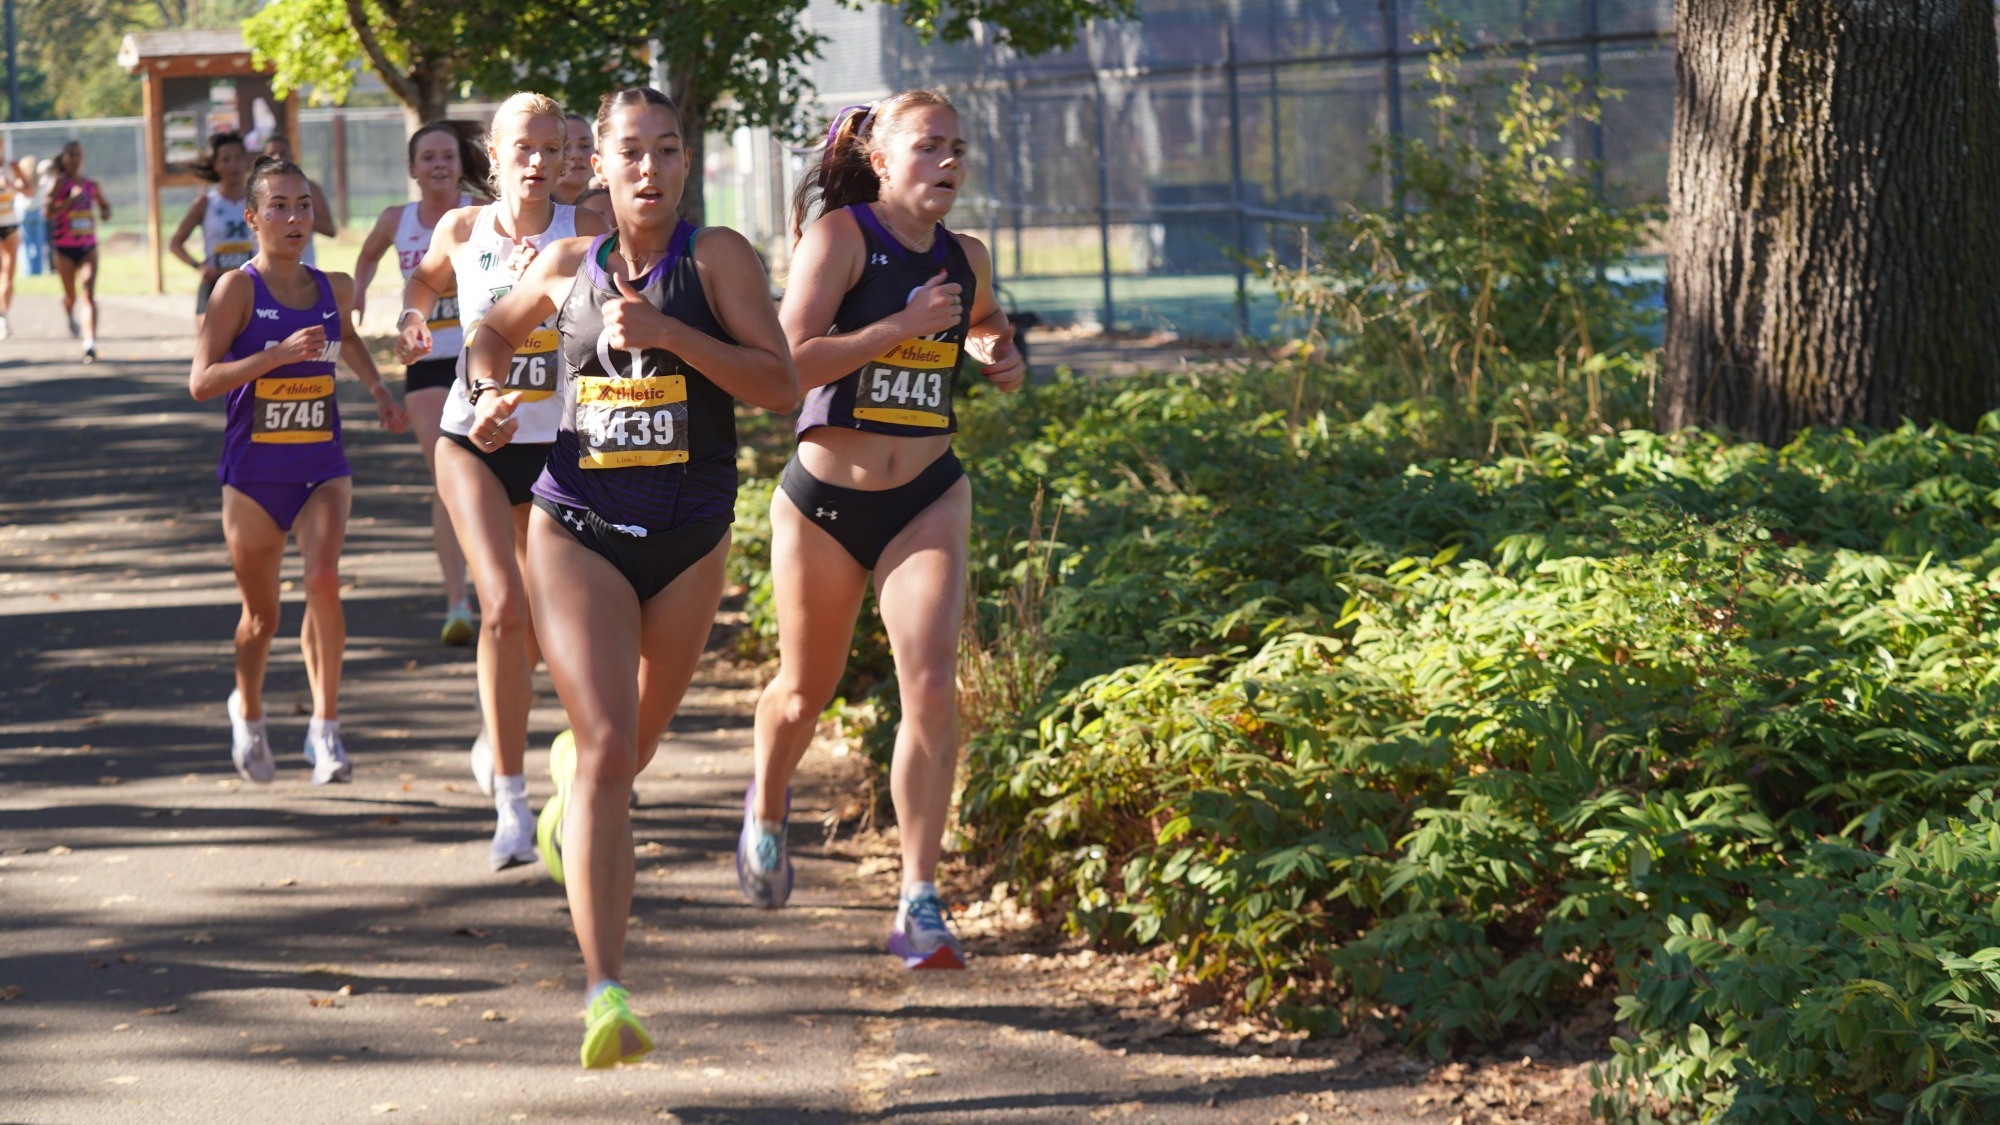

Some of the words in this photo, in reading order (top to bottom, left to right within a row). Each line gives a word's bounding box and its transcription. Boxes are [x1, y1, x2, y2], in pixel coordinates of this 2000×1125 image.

[504, 356, 546, 386] 76
[597, 385, 665, 401] Athletic
[870, 368, 942, 407] 5443
[265, 400, 325, 429] 5746
[588, 410, 673, 447] 5439
